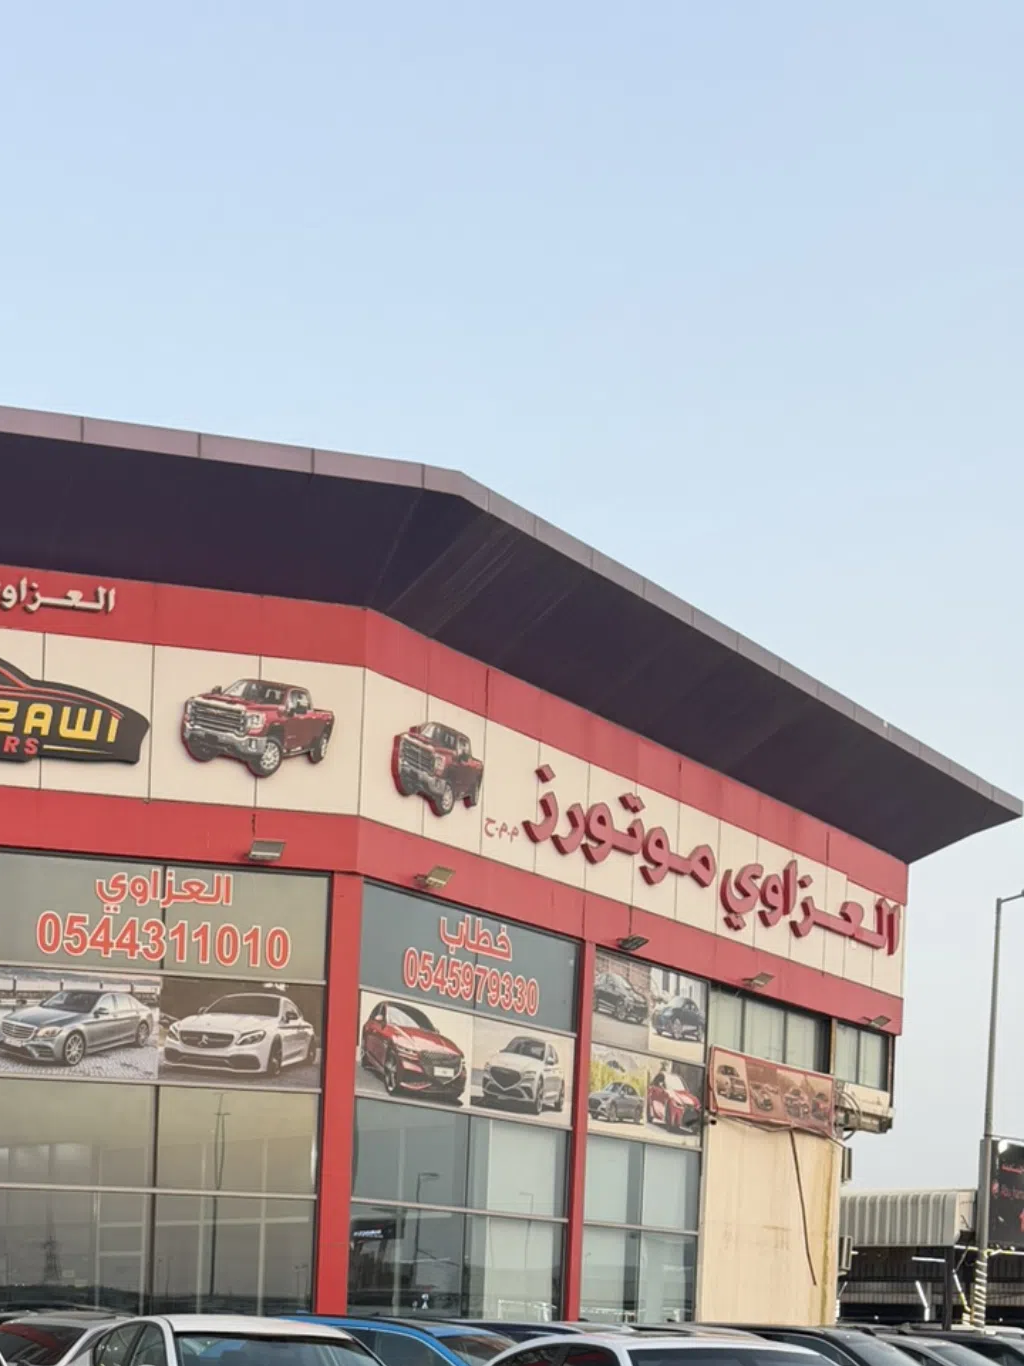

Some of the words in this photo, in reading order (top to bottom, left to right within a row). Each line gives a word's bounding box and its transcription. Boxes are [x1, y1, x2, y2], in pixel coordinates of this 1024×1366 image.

[522, 763, 718, 888] موتورز
[95, 867, 233, 914] العزاوي
[720, 859, 901, 956] العزاوي
[36, 910, 291, 969] 0544311010
[439, 914, 513, 962] خطاب
[403, 946, 539, 1016] 0545979330
